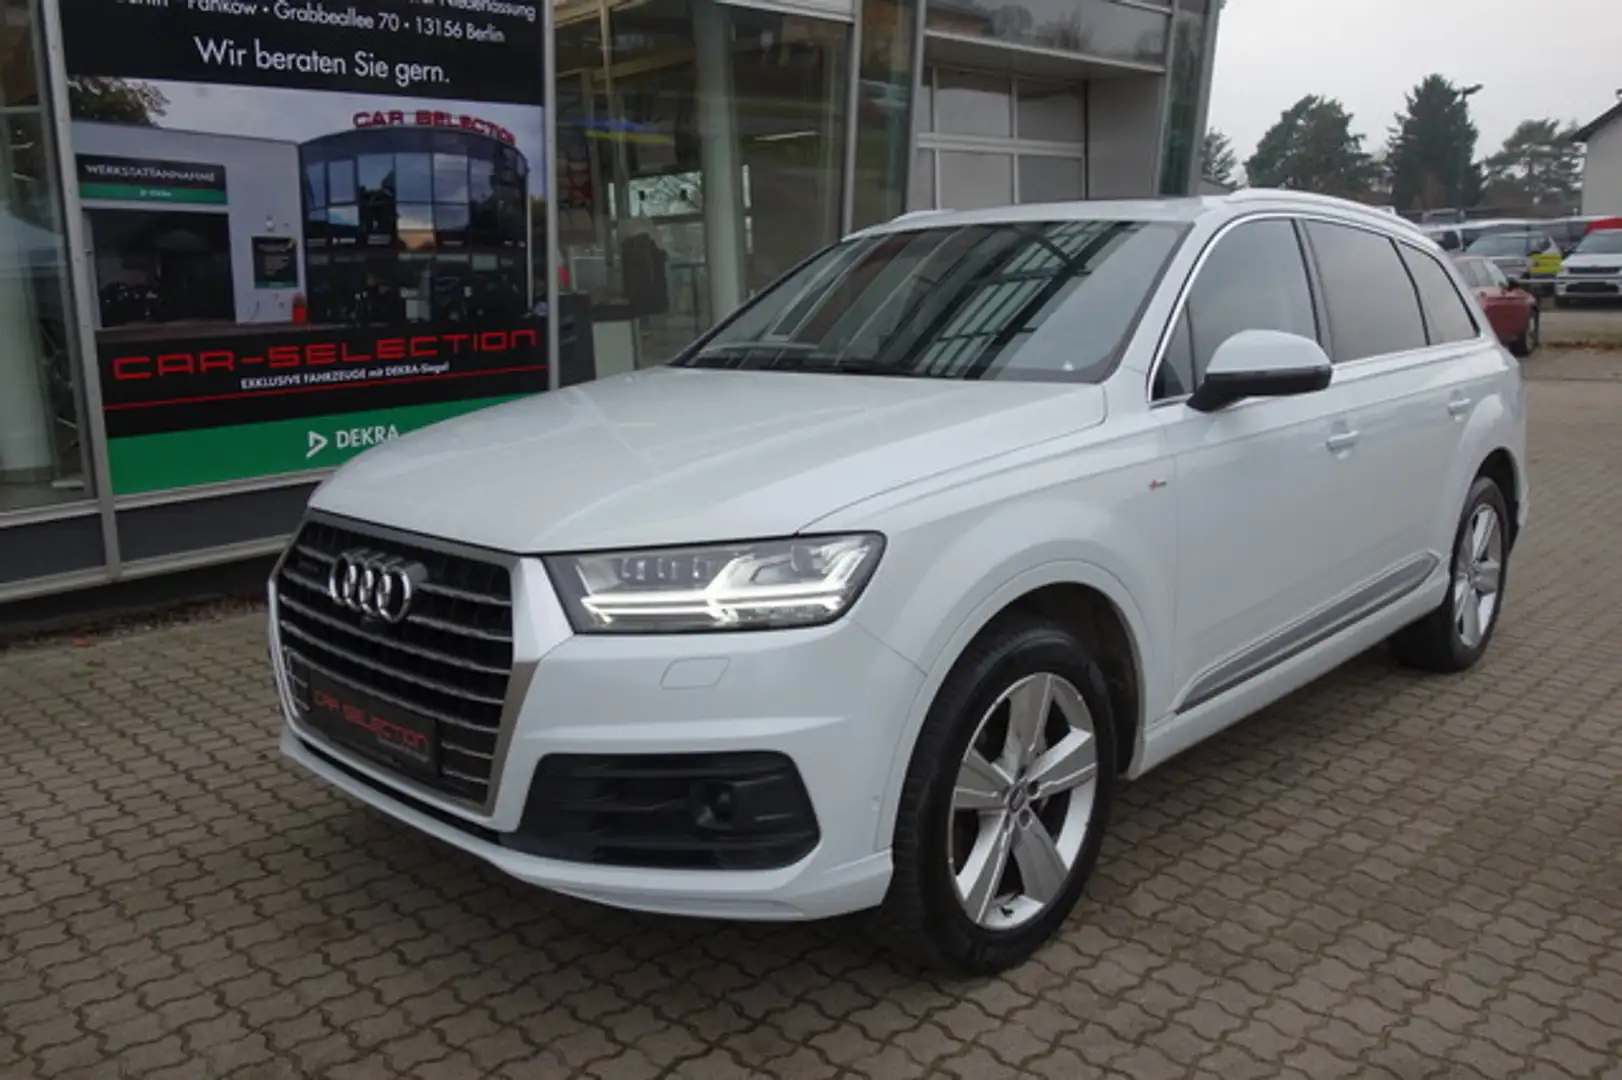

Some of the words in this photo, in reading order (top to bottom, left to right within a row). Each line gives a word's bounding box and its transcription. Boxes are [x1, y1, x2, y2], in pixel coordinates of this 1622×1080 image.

[273, 0, 374, 29] Grabbeallee
[377, 12, 400, 32] 70
[415, 16, 463, 39] 13156
[466, 23, 506, 43] Berlin
[193, 36, 248, 67] Wir
[254, 38, 347, 75] beraten
[353, 51, 390, 78] Sie
[394, 62, 450, 87] gern.
[335, 423, 400, 449] DEKRA
